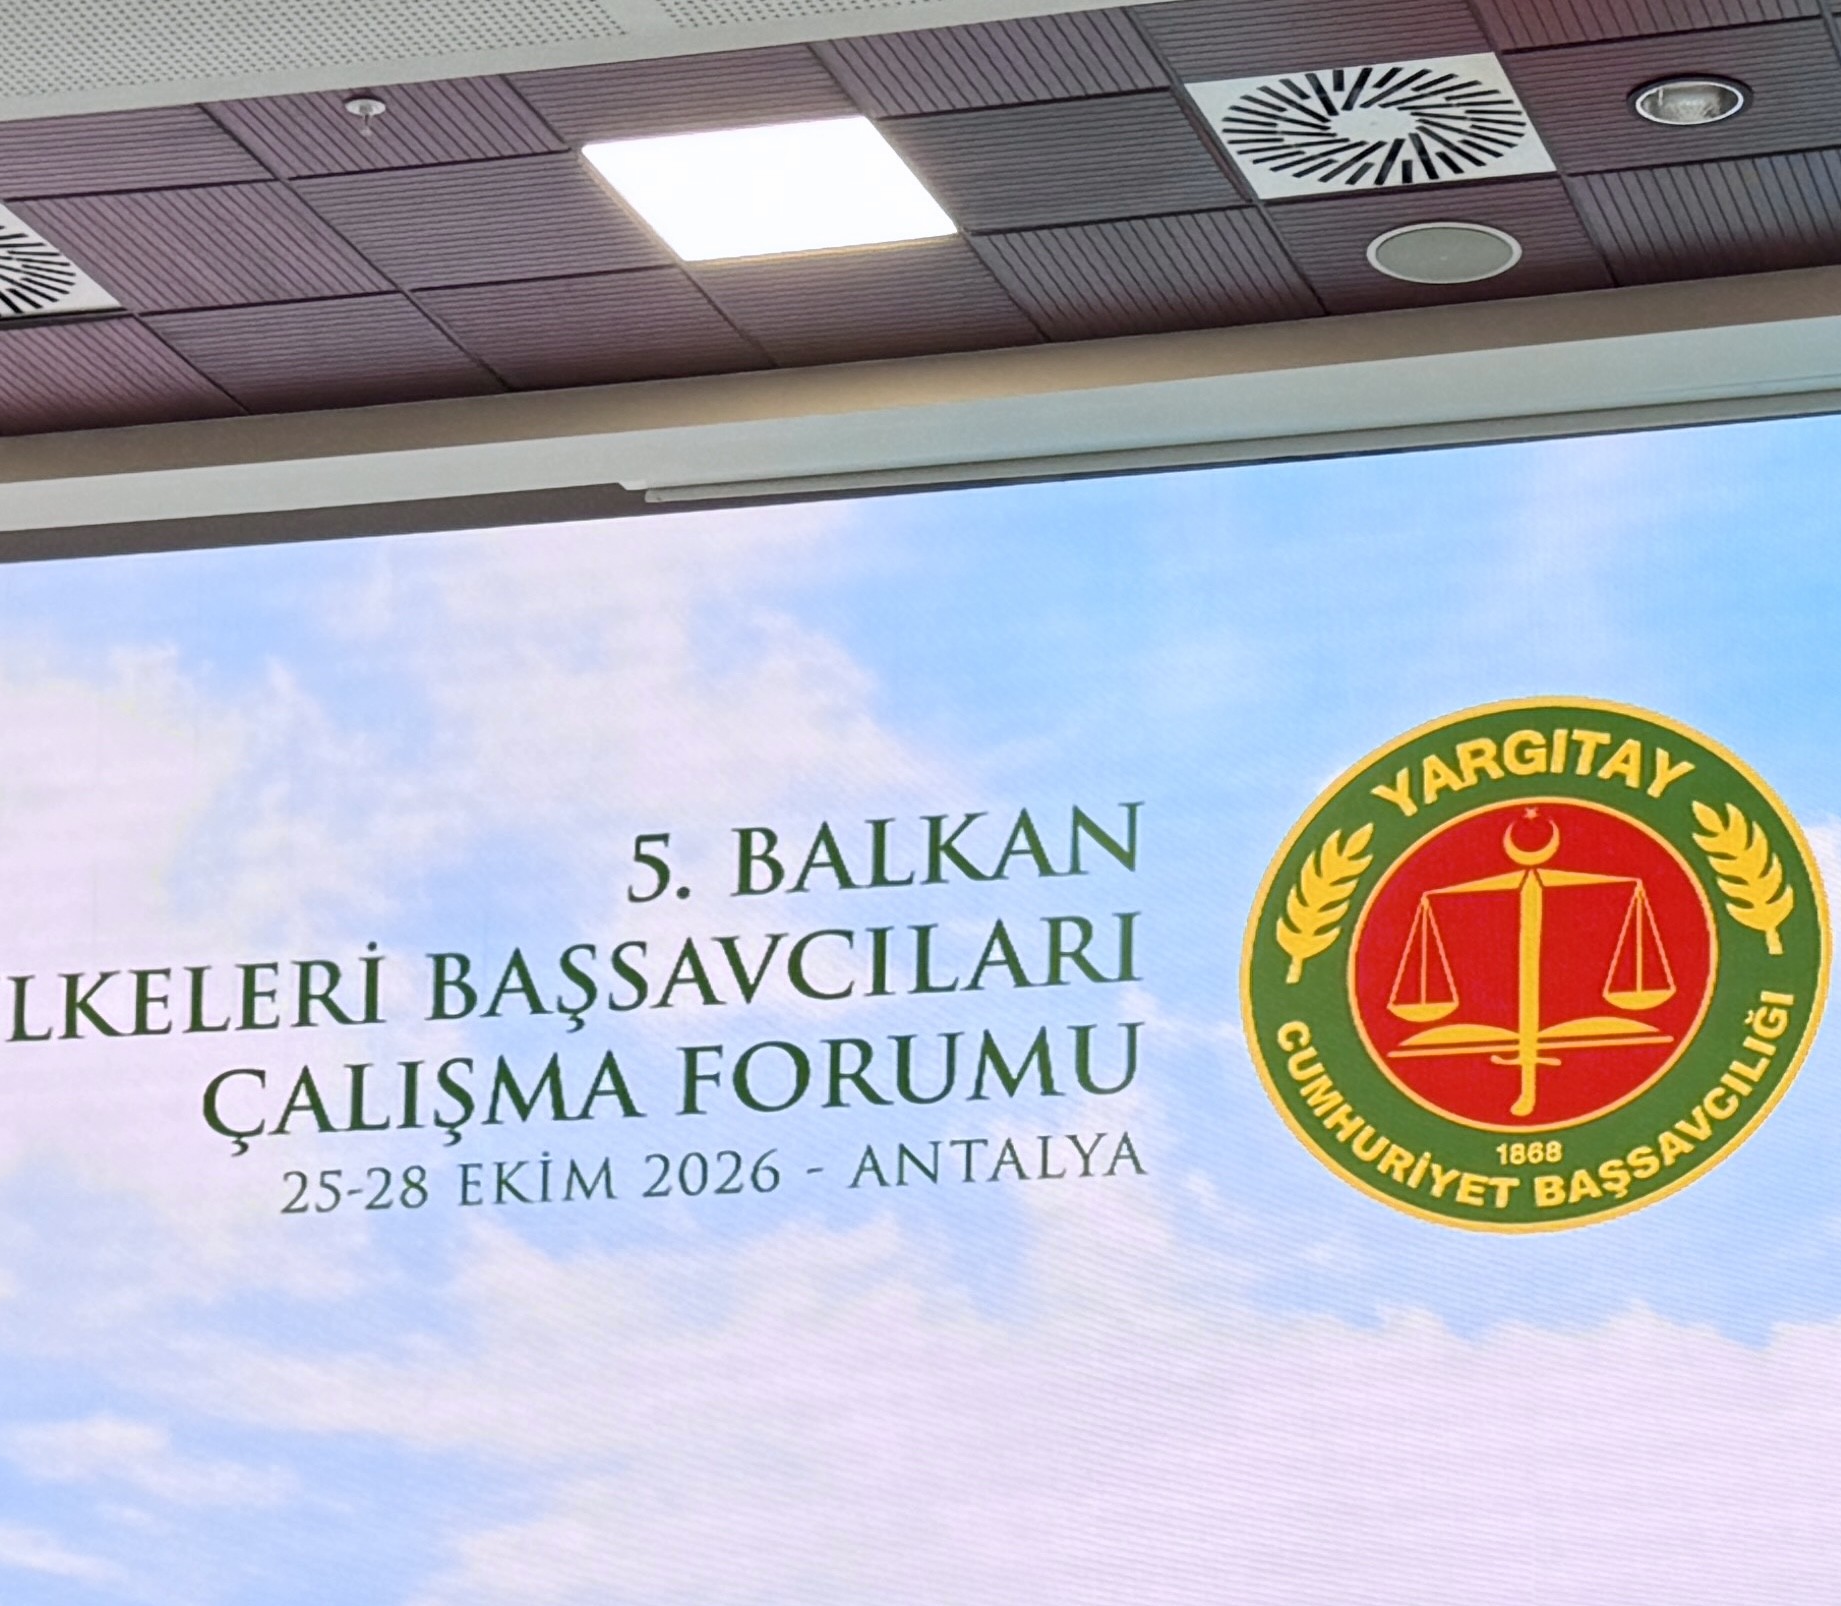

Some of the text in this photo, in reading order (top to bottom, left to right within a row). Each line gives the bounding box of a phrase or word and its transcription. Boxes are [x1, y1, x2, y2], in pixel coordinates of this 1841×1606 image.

[1371, 727, 1695, 818] YARGITAY
[627, 802, 1140, 903] 5. BALKAN
[425, 912, 1138, 1033] BAŞSAVCILARI
[202, 1022, 1143, 1157] ÇALIŞMA FORUMU
[1276, 990, 1795, 1209] CUMHURİYET BAŞSAVCILIĞI
[281, 1165, 428, 1214] 25-28
[460, 1148, 615, 1206] EKİM
[643, 1148, 780, 1198] 2026
[850, 1131, 1146, 1188] ANTALYA
[1495, 1140, 1563, 1166] 1868
